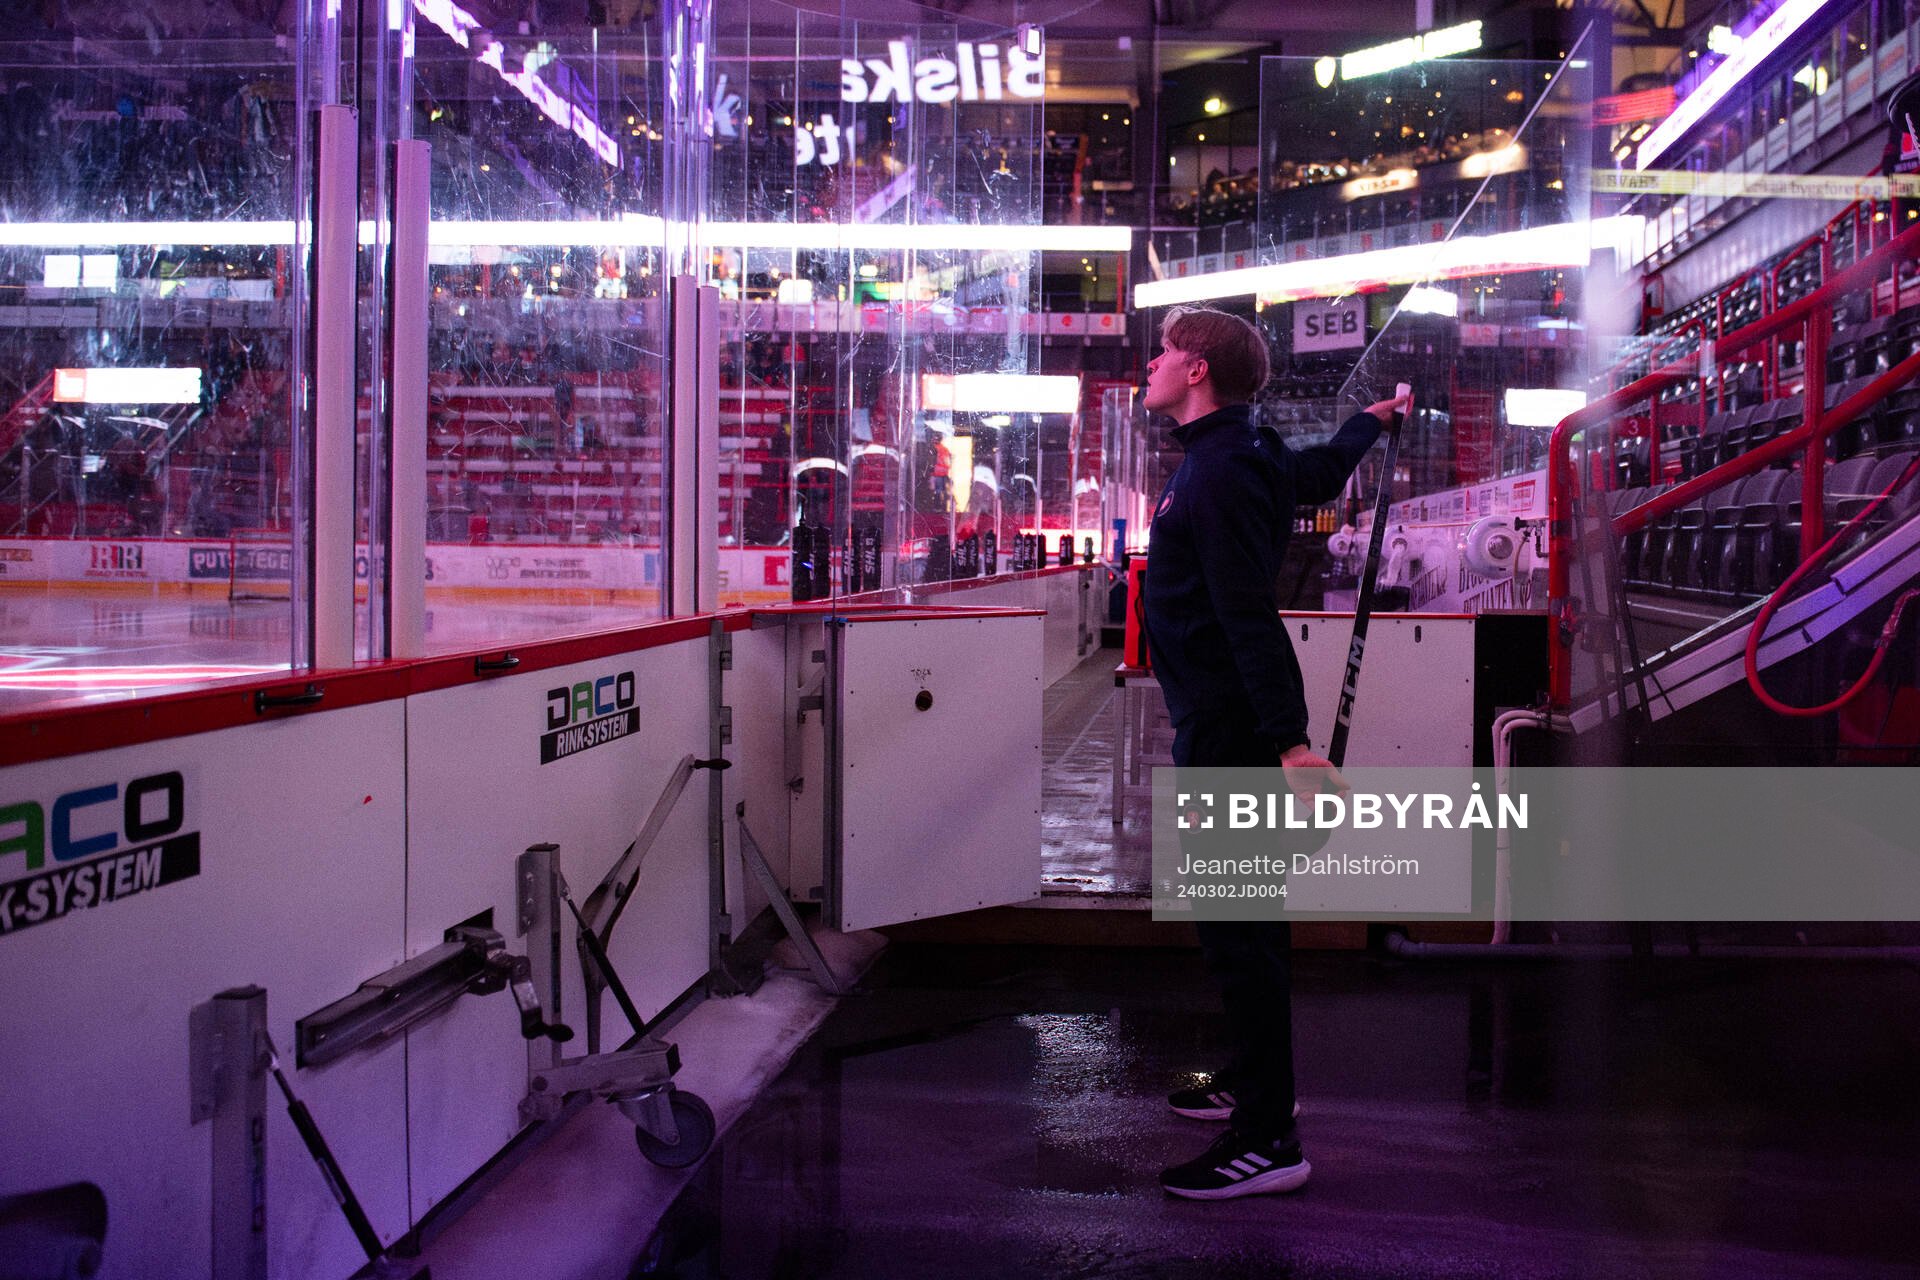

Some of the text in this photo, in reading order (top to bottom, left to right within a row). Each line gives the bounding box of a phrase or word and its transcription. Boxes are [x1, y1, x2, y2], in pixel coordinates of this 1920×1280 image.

[1305, 310, 1357, 337] SEB
[1628, 419, 1638, 435] 3
[547, 670, 635, 731] DACO
[1337, 634, 1365, 728] CCM
[556, 713, 629, 757] RINK-SYSTEM
